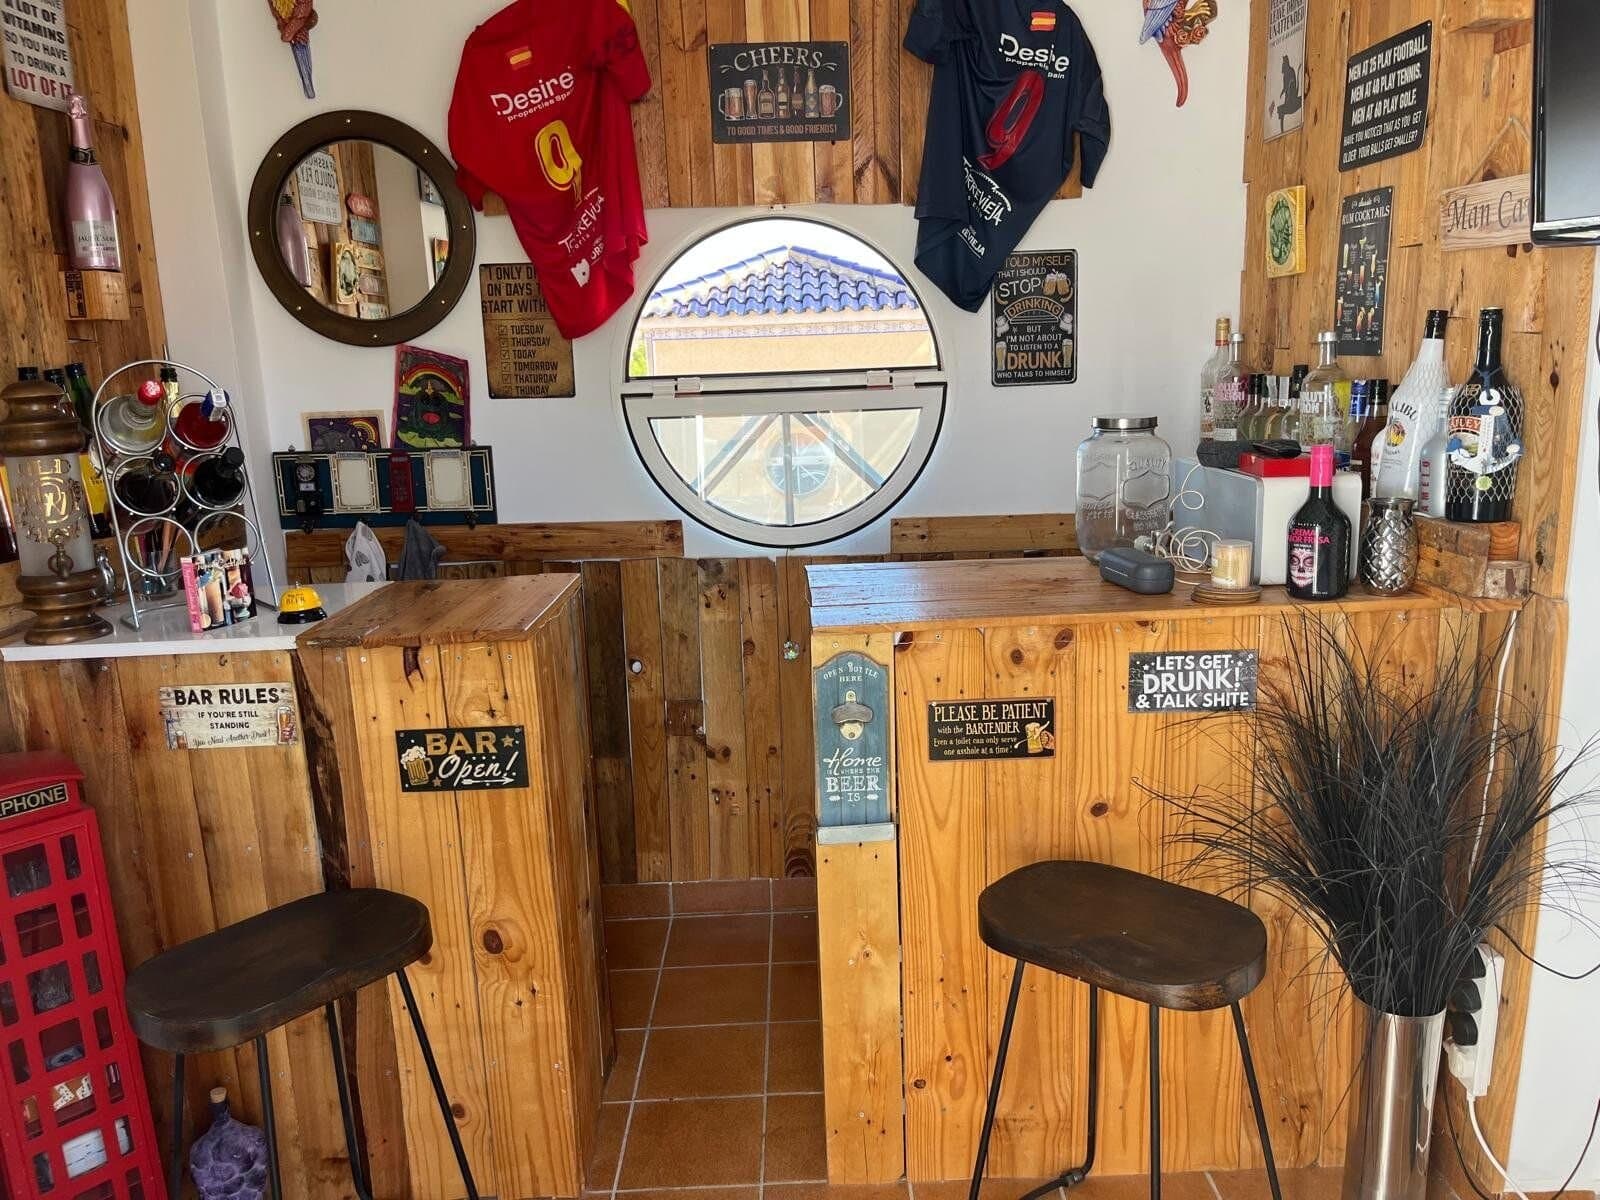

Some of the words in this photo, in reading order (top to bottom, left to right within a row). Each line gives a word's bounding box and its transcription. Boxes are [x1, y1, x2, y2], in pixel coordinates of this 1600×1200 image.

[17, 1, 38, 18] LOT
[41, 9, 57, 25] OF
[2, 10, 65, 44] VITAMINS
[4, 29, 18, 44] SO
[20, 35, 40, 52] YOU
[42, 44, 69, 61] HAVE
[11, 50, 25, 64] TO
[27, 55, 58, 76] DRINK
[734, 46, 823, 72] CHEERS
[1348, 62, 1362, 83] MEN
[1362, 59, 1370, 77] AT
[1377, 48, 1393, 70] PLAY
[1393, 34, 1428, 64] FOOTBALL.
[1005, 57, 1049, 71] properti
[1047, 71, 1065, 79] pain
[11, 67, 36, 92] LOT
[40, 76, 57, 98] OF
[1350, 83, 1364, 105] MEN
[1364, 80, 1372, 99] AT
[1372, 77, 1380, 95] 40
[1380, 71, 1397, 93] PLAY
[490, 72, 574, 116] Desire
[1351, 105, 1366, 126] MEN
[1365, 103, 1375, 122] AT
[1382, 94, 1399, 116] PLAY
[1394, 118, 1401, 131] AS
[1412, 110, 1423, 124] GET
[727, 126, 736, 136] TO
[738, 126, 756, 136] GOOD
[785, 124, 804, 135] GOOD
[1446, 194, 1491, 233] Man
[1498, 190, 1529, 229] Ca
[1032, 254, 1072, 267] MYSELF
[496, 266, 526, 280] ONLY
[997, 270, 1015, 279] THAT
[1020, 267, 1047, 277] SHOULD
[487, 282, 501, 297] ON
[505, 282, 533, 297] DAYS
[999, 277, 1042, 298] STOP
[481, 300, 514, 314] START
[517, 299, 546, 313] WITH
[1007, 297, 1061, 318] DRINKING
[510, 324, 545, 335] TUESDAY
[1019, 334, 1035, 343] NOT
[1036, 333, 1063, 342] ABOUT
[1026, 325, 1041, 333] BUT
[512, 336, 551, 347] THURSDAY
[1010, 344, 1019, 352] TO
[1019, 343, 1042, 351] LISTEN
[1043, 342, 1052, 350] TO
[512, 349, 537, 359] TODAY
[1007, 351, 1062, 370] DRUNK
[513, 361, 559, 372] TOMORROW
[1013, 370, 1033, 378] TALKS
[1044, 368, 1072, 377] HIMSELF
[1450, 417, 1481, 432] AILEY
[1156, 655, 1195, 671] LETS
[1199, 653, 1233, 670] GET
[823, 667, 844, 680] OPEN
[839, 675, 863, 683] HERE
[1143, 667, 1241, 695] DRUNK!
[174, 689, 213, 706] BAR
[219, 687, 280, 705] RULES
[1135, 694, 1151, 709] &
[1153, 692, 1199, 709] TALK
[1202, 691, 1250, 708] SHITE
[198, 711, 205, 719] IF
[207, 710, 236, 719] YOU'RE
[238, 710, 259, 718] STILL
[934, 705, 979, 723] PLEASE
[982, 704, 999, 721] BE
[1002, 702, 1049, 720] PATIENT
[209, 721, 250, 730] STANDING
[937, 724, 952, 735] with
[953, 724, 964, 734] the
[966, 720, 1021, 736] BARTENDER
[424, 731, 498, 756] BAR
[933, 737, 948, 747] Even
[985, 736, 999, 745] only
[438, 751, 520, 787] Open!
[823, 747, 882, 776] Home
[825, 775, 883, 793] BEER
[0, 786, 66, 817] PHONE
[847, 792, 861, 802] IS
